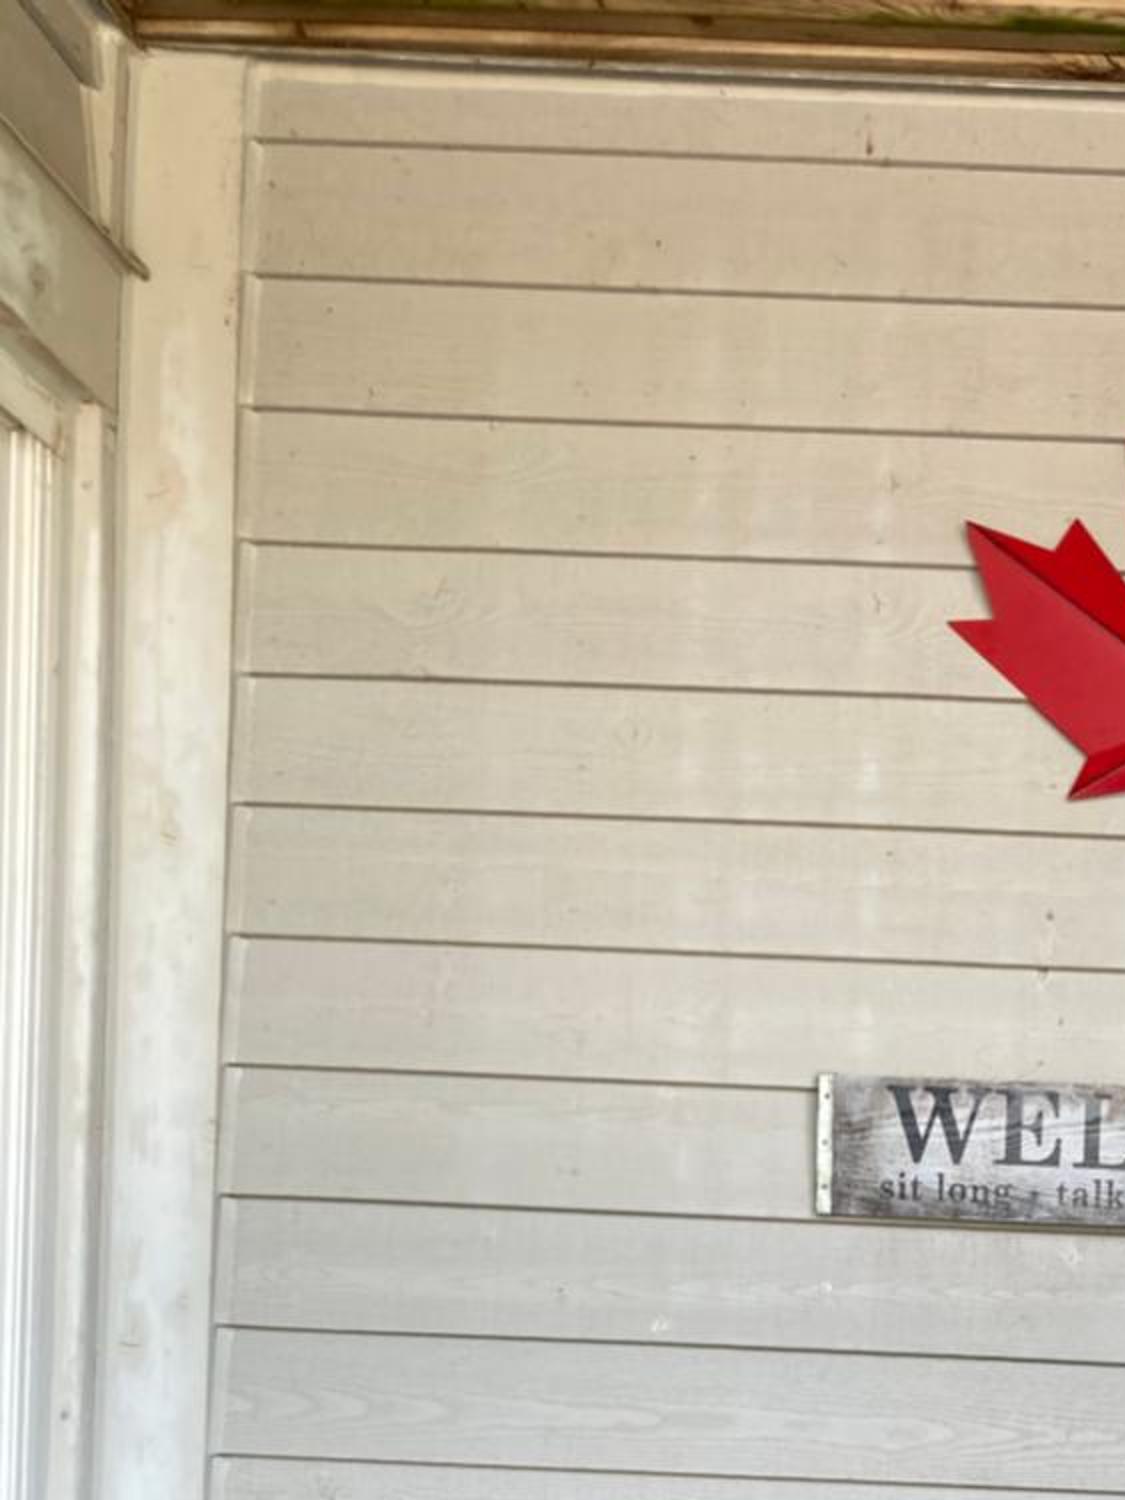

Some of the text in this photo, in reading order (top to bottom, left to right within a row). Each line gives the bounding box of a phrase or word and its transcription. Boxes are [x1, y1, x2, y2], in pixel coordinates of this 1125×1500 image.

[879, 1172, 922, 1202] sit
[937, 1172, 1014, 1213] long
[1056, 1179, 1124, 1211] talk
